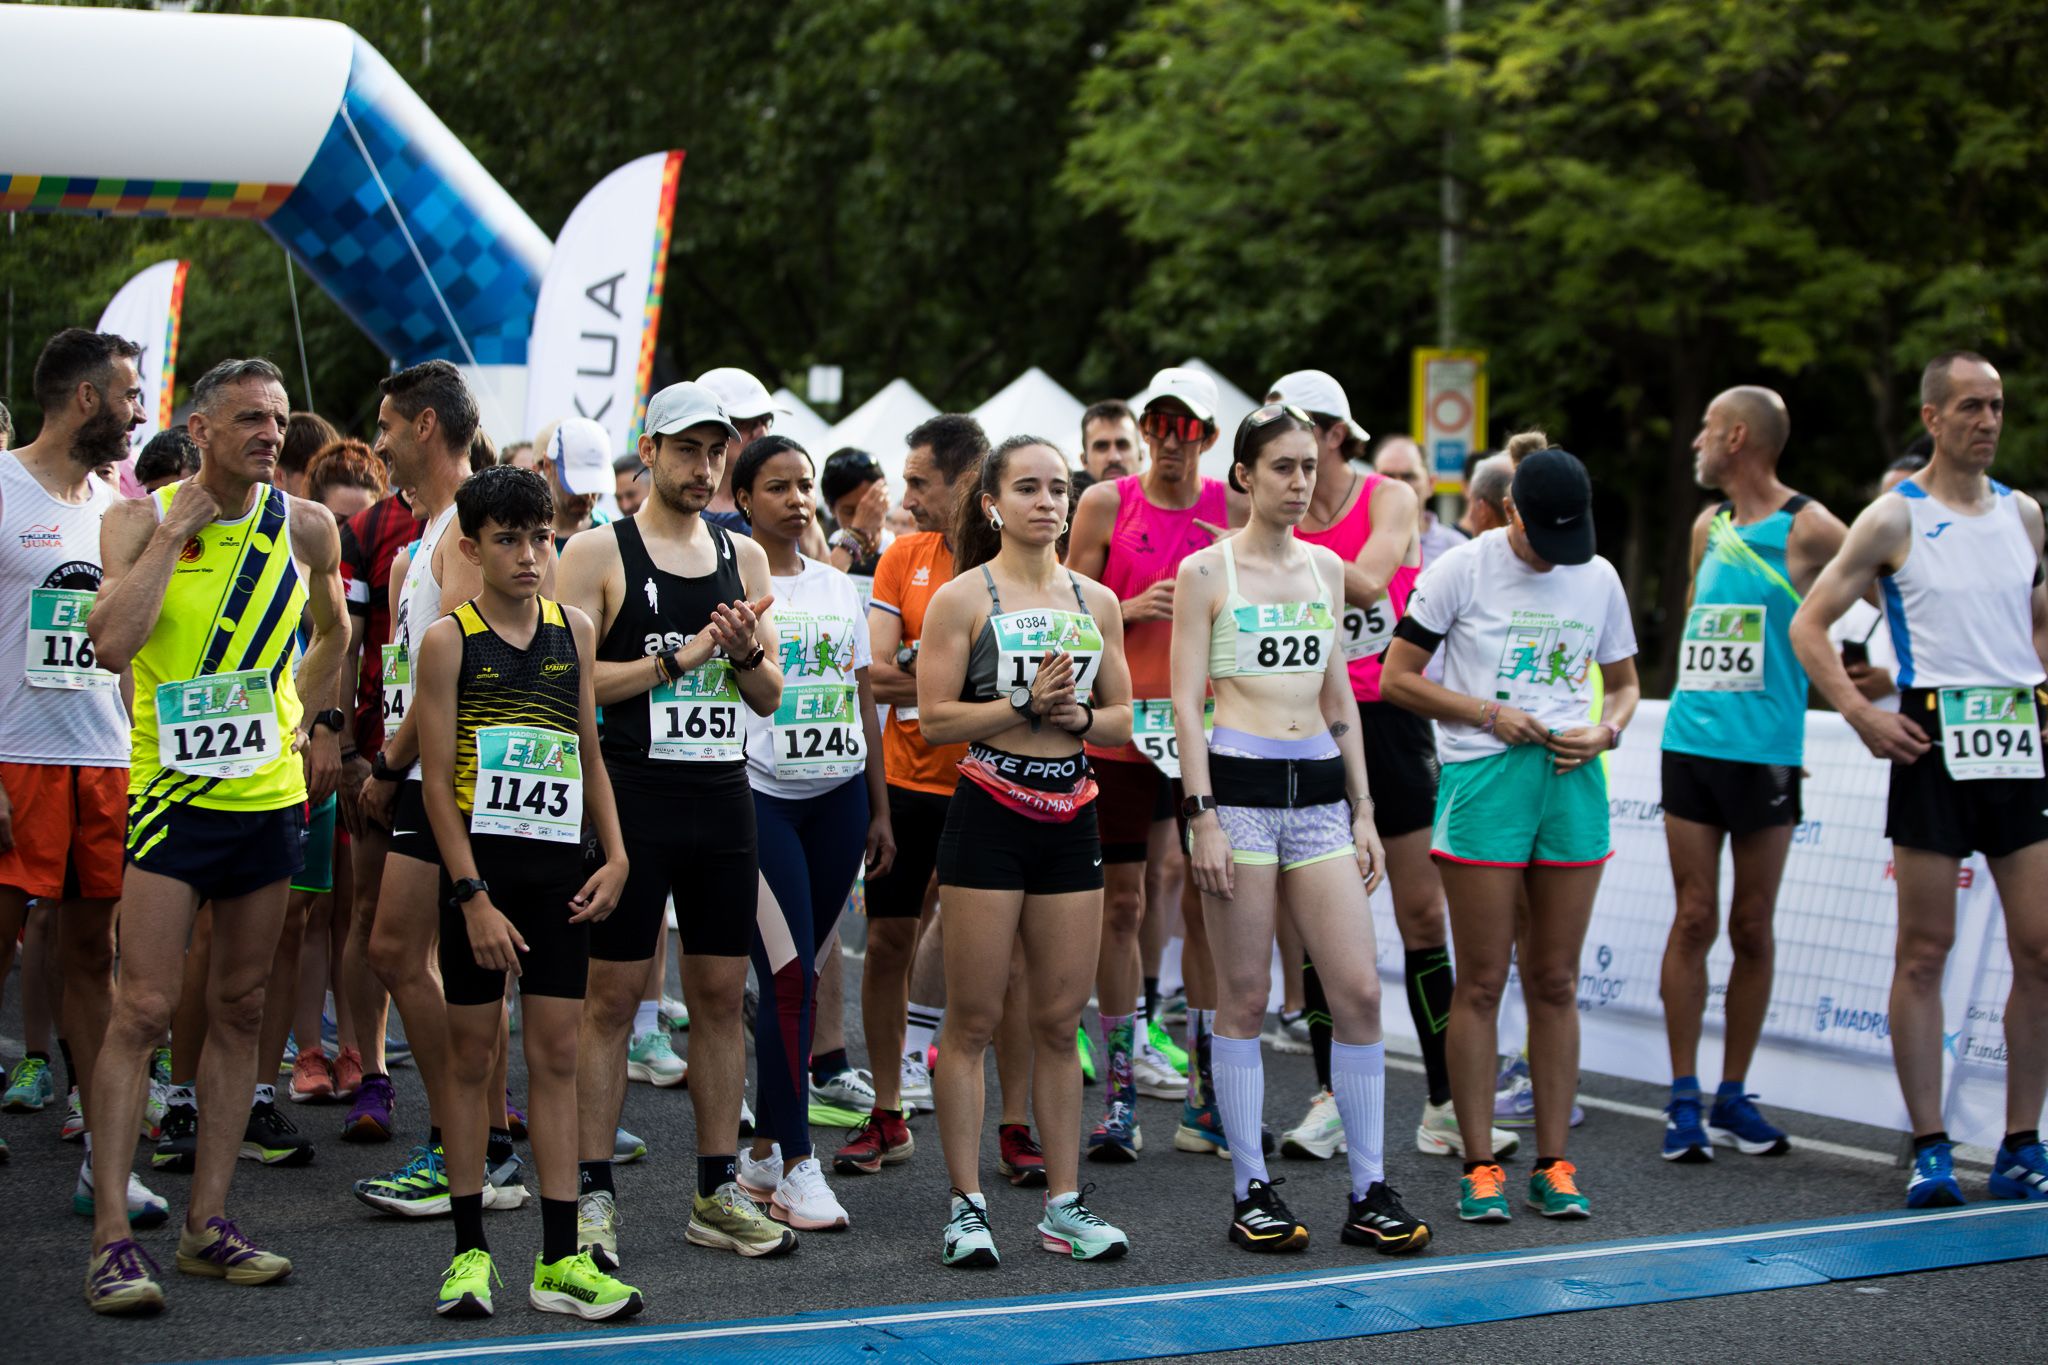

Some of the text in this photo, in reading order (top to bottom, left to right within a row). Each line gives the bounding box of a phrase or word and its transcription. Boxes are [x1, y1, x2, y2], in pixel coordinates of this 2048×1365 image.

[23, 539, 64, 549] JUMA
[52, 600, 88, 627] EL
[1016, 615, 1048, 629] 0384
[1258, 602, 1316, 628] ELA
[1562, 620, 1585, 630] CON
[1697, 613, 1745, 638] ELA
[42, 635, 100, 669] 116
[1257, 635, 1321, 668] 828
[1686, 645, 1754, 673] 1036
[674, 670, 730, 697] ELA
[1010, 655, 1093, 687] 177
[182, 684, 249, 717] ELA
[795, 693, 847, 720] ELA
[1965, 695, 2017, 721] ELA
[508, 731, 538, 739] MADRID
[665, 706, 736, 739] 1651
[174, 719, 266, 761] 1224
[784, 727, 860, 759] 1246
[1953, 728, 2034, 758] 1094
[502, 737, 564, 772] ELA
[968, 746, 1022, 774] NIKE
[1023, 760, 1076, 779] PRO
[486, 776, 570, 817] 1143
[1046, 799, 1076, 812] MAX
